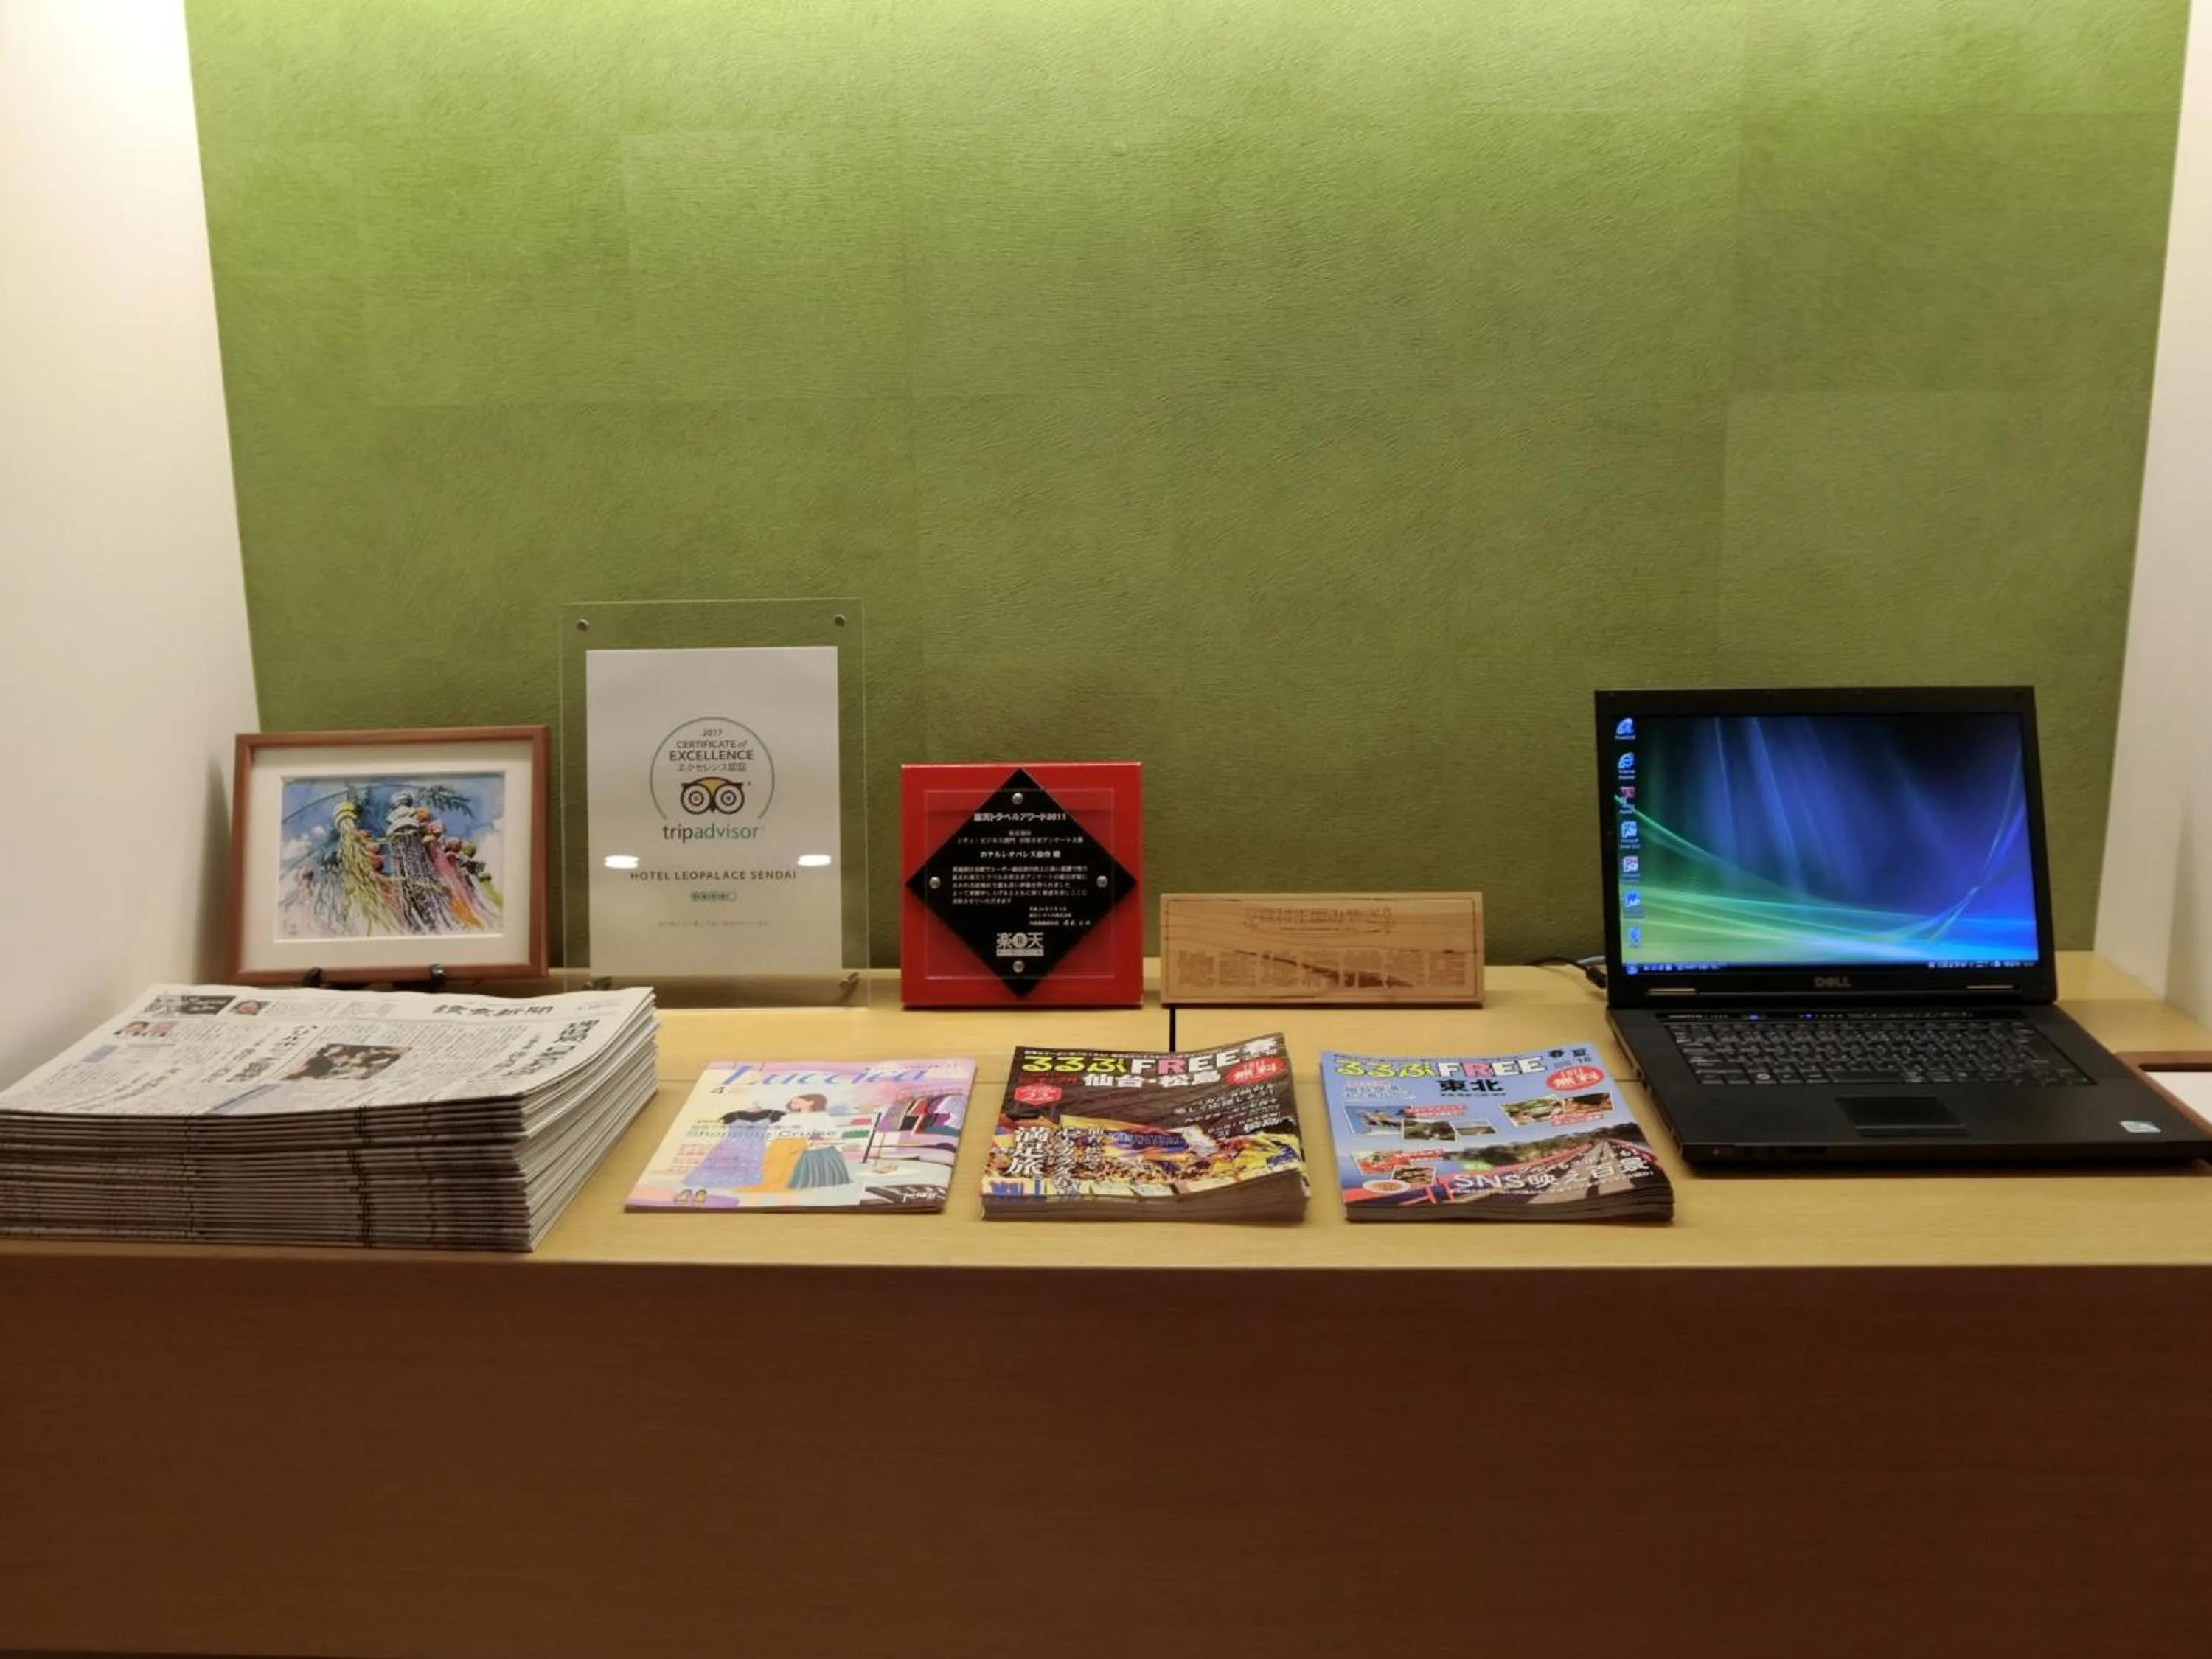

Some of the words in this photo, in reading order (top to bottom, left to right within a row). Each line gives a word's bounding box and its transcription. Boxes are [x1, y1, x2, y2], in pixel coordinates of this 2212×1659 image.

[703, 728, 723, 737] 2017
[676, 740, 736, 748] CERTIFICATE
[738, 739, 748, 748] of
[669, 750, 754, 761] EXCELLENCE
[662, 822, 758, 843] tripadvisor
[630, 871, 670, 880] HOTEL
[675, 870, 745, 880] LEOPALACE
[750, 870, 796, 880] SENDAI
[1814, 976, 1851, 988] DELL
[1438, 1079, 1504, 1092] 東北
